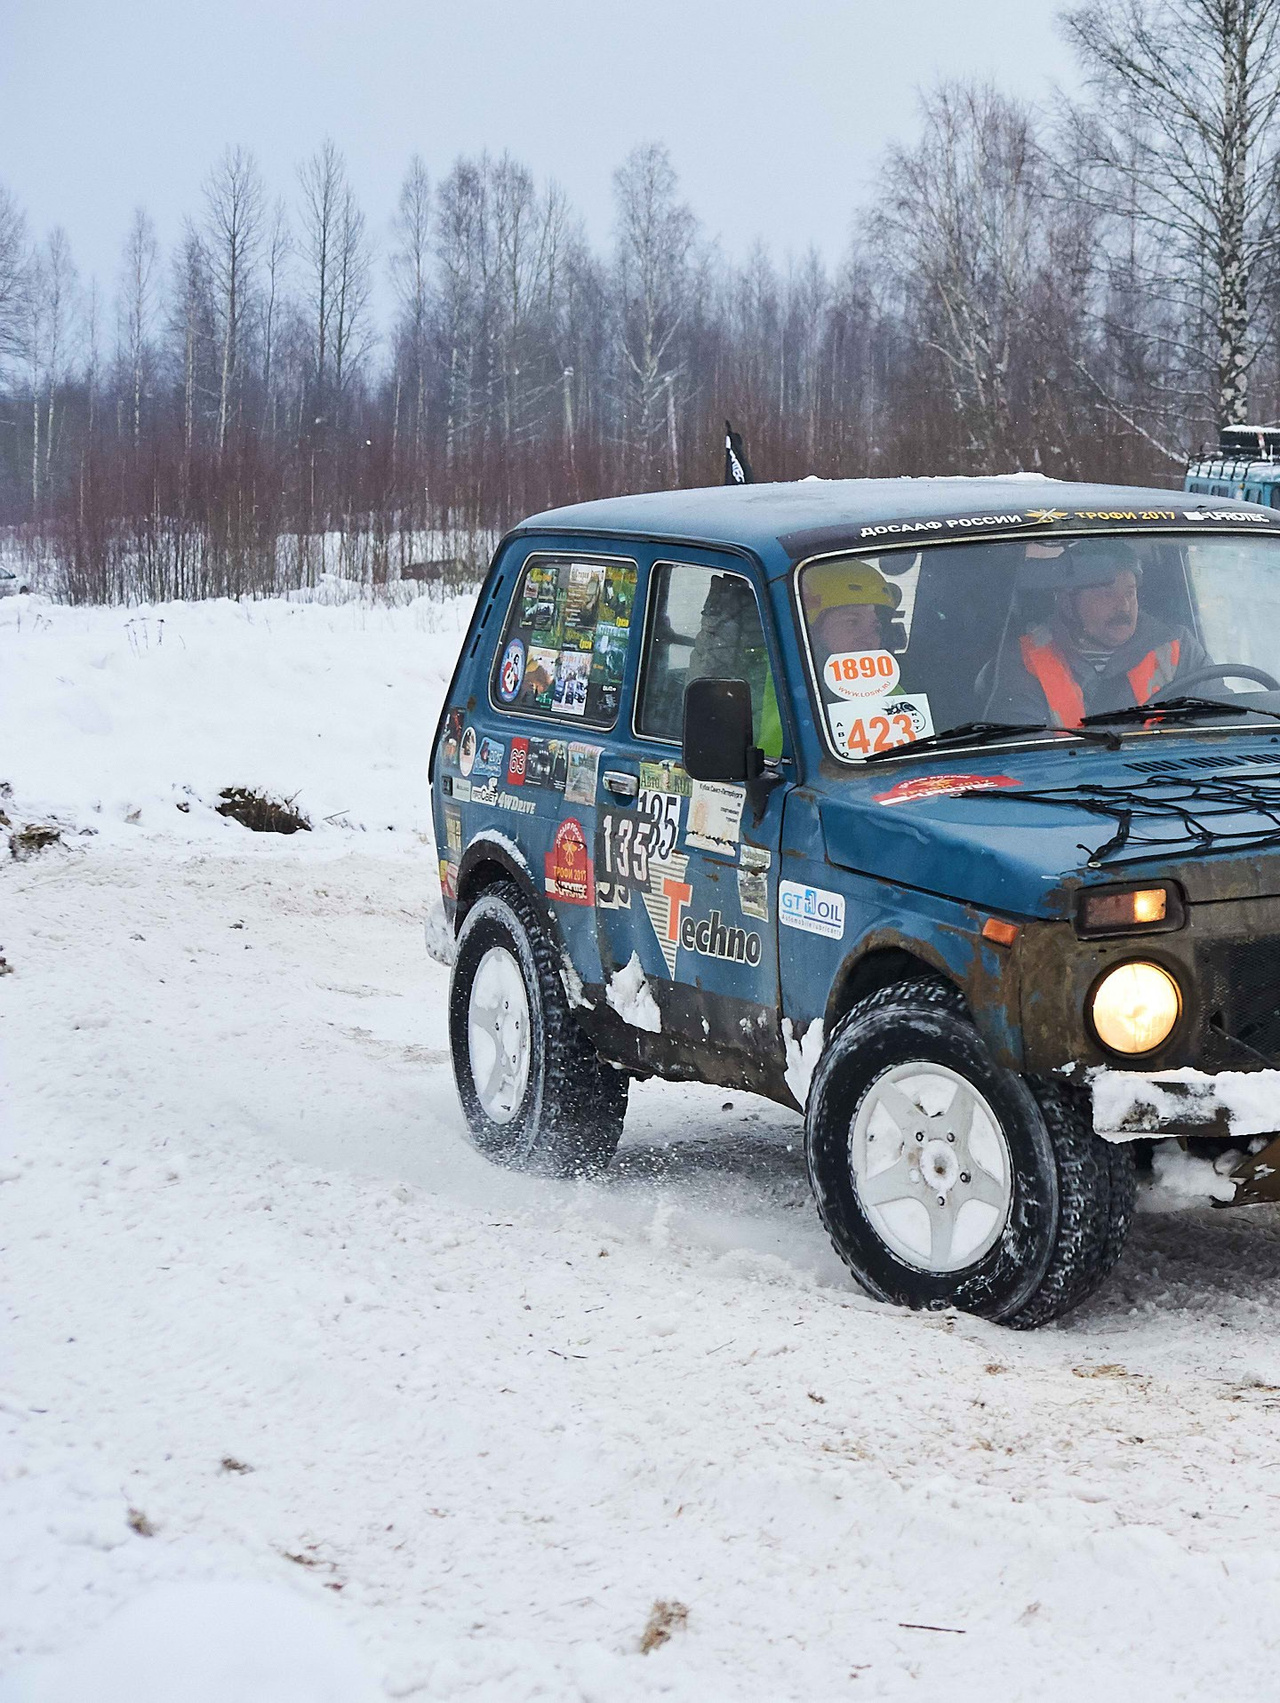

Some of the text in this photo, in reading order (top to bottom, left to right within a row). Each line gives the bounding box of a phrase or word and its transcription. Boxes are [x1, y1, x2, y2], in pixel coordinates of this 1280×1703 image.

[860, 511, 1176, 538] ДОСААФ РОССИИ ТРОФИ 2017
[829, 655, 894, 682] 1890
[847, 714, 917, 754] 423
[509, 748, 526, 775] 63
[603, 815, 651, 882] 135
[662, 877, 762, 967] Techno
[782, 892, 842, 922] GT OIL
